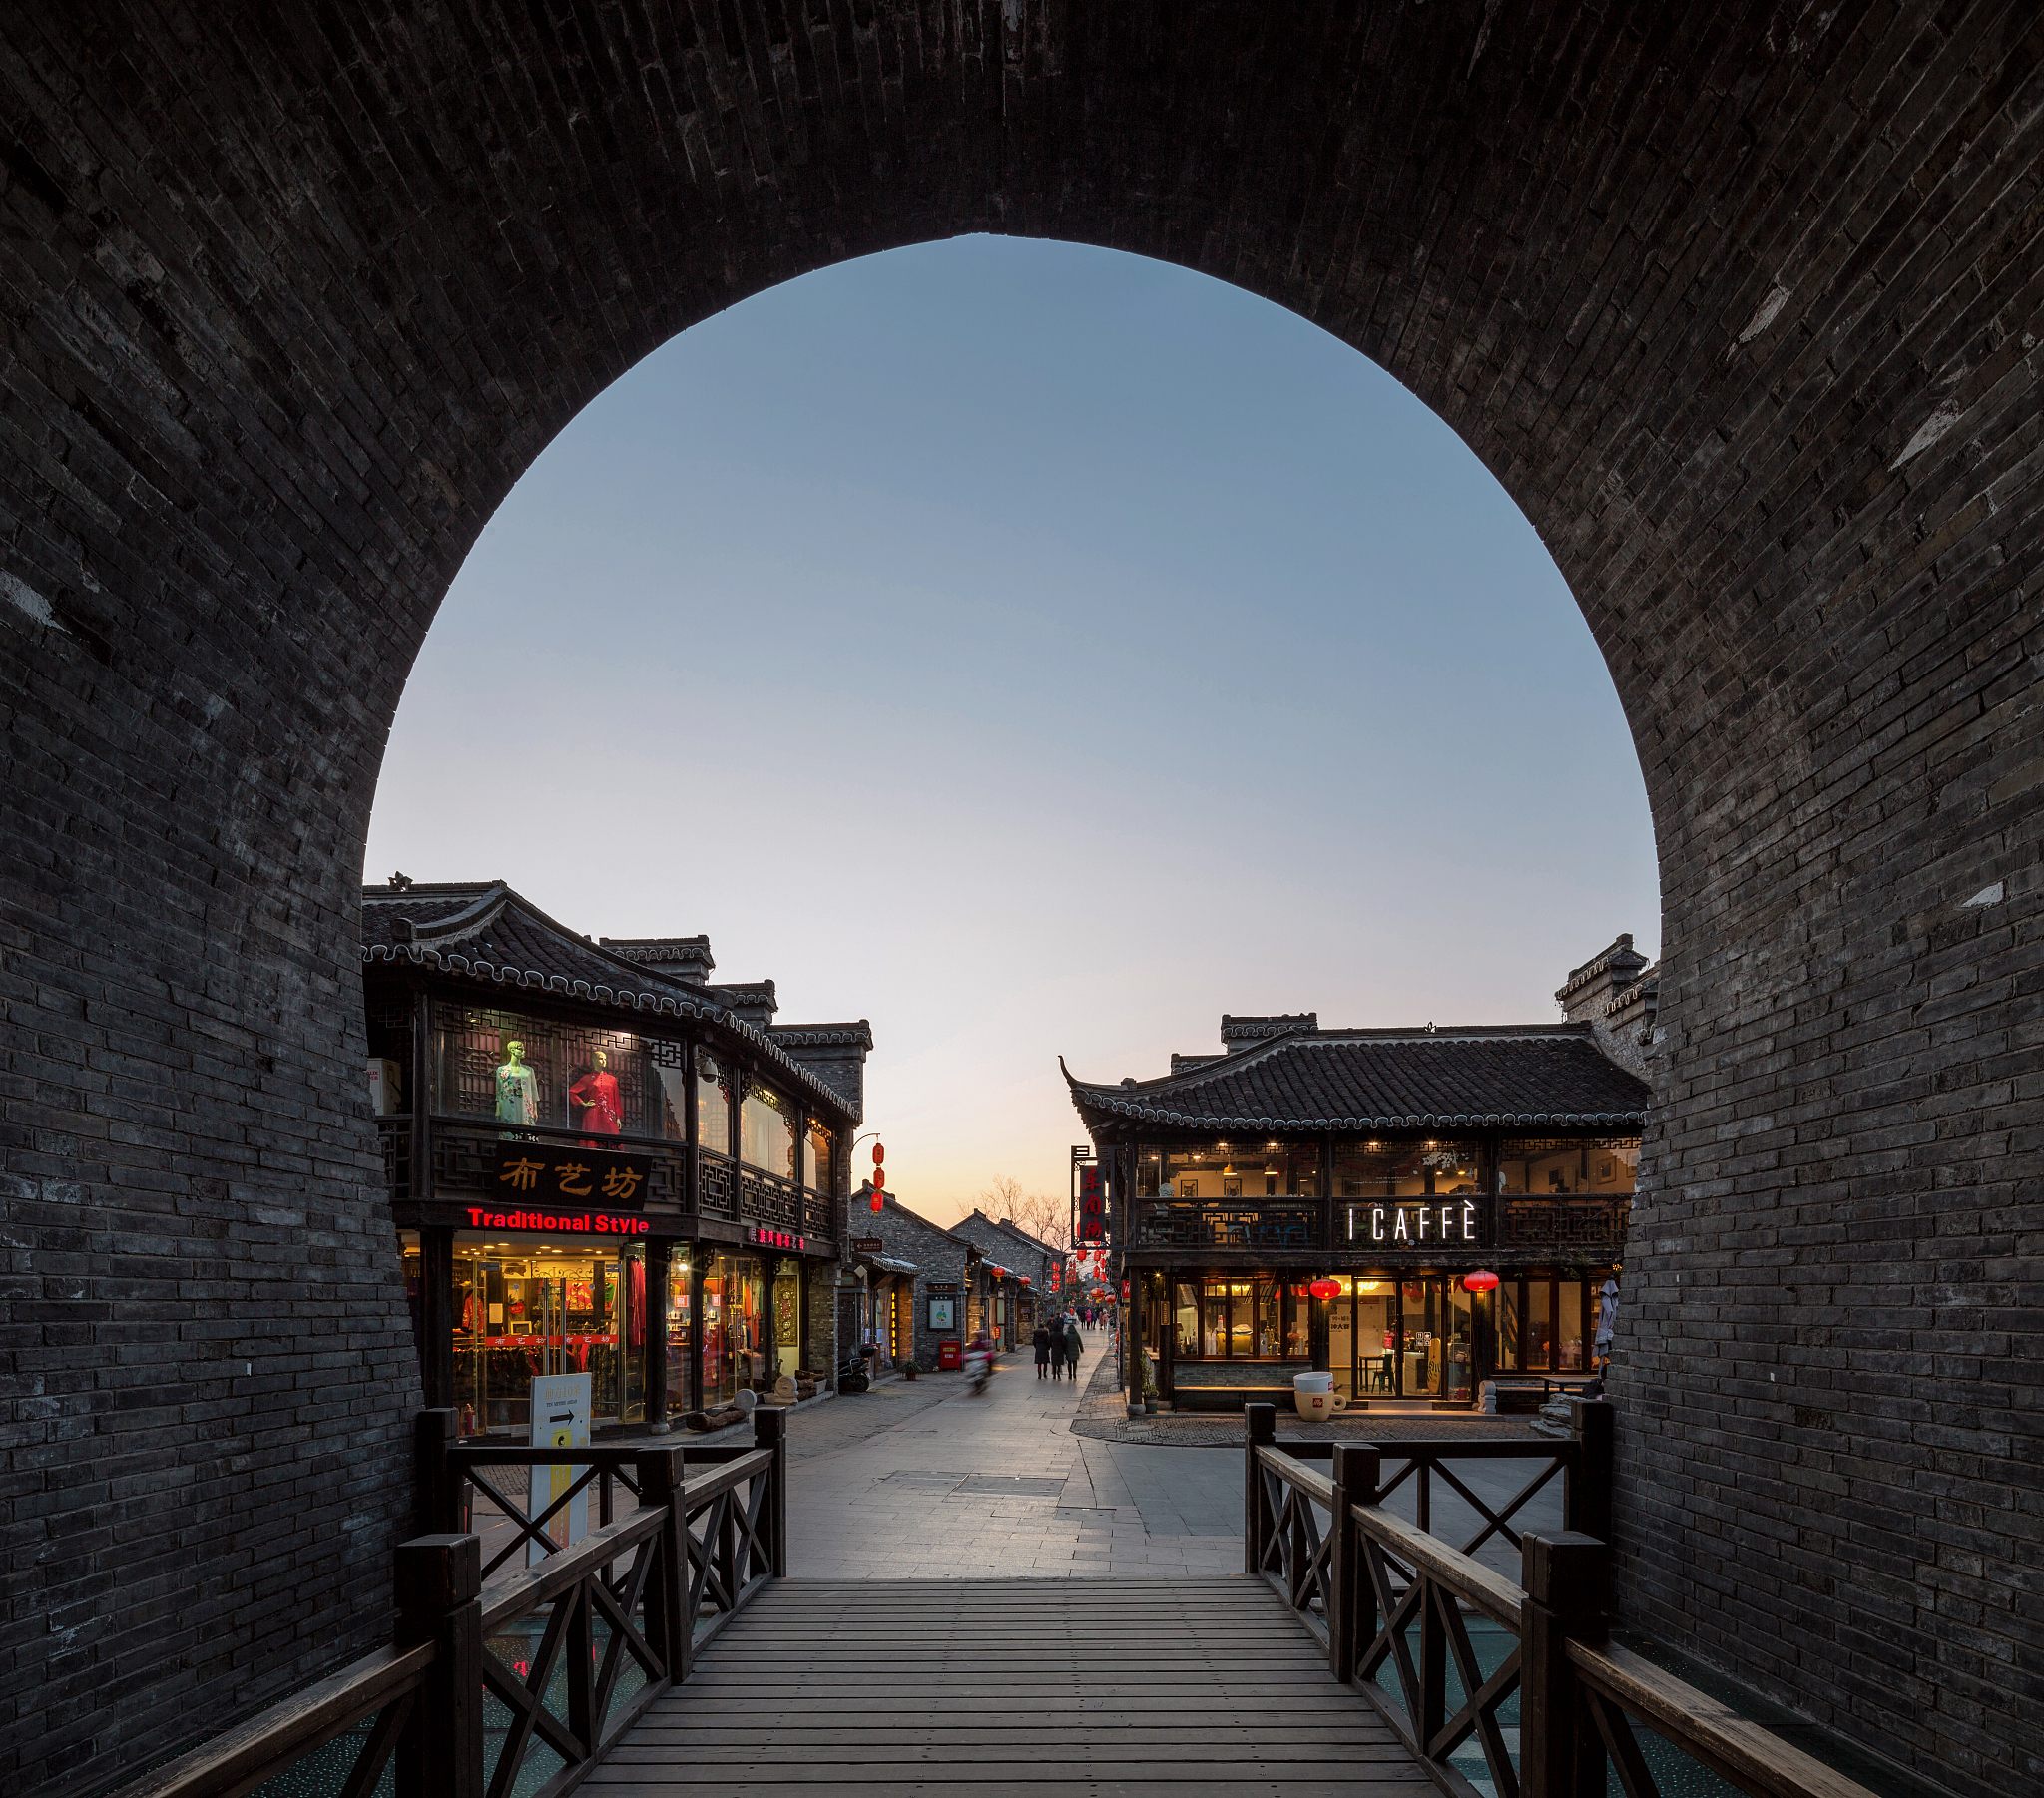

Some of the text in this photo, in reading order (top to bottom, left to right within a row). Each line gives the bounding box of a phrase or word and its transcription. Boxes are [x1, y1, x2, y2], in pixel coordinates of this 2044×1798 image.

[499, 1157, 644, 1199] 布艺坊
[467, 1208, 650, 1235] Traditional Style
[1372, 1199, 1476, 1240] CAFFÈ
[545, 1384, 581, 1400] 前方10米
